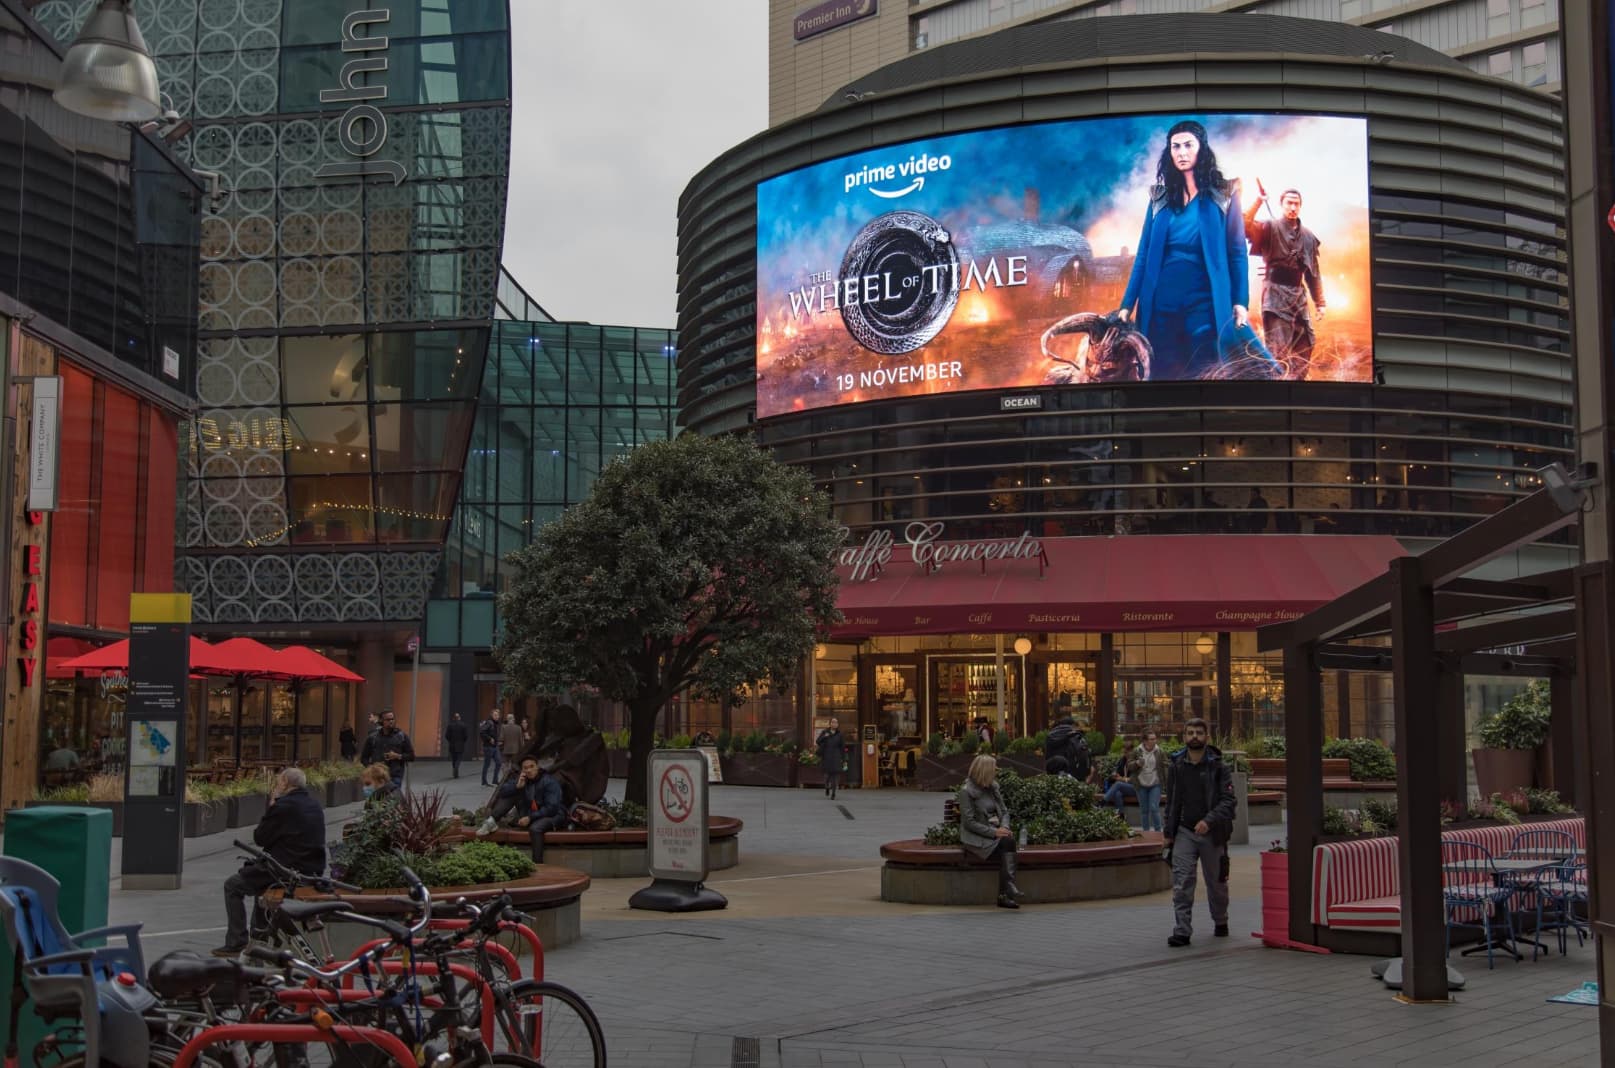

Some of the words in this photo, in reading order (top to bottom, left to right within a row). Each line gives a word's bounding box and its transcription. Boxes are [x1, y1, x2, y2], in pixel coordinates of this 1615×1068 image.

[797, 11, 834, 32] Premier
[836, 6, 851, 18] Inn
[844, 165, 895, 192] prime
[898, 153, 951, 176] video
[789, 271, 902, 320] WHEEL
[902, 275, 920, 289] OF
[922, 256, 1028, 294] TIME
[811, 270, 831, 284] THE
[837, 374, 854, 390] 19
[860, 361, 962, 388] NOVEMBER
[1004, 398, 1038, 407] OCEAN
[905, 521, 1042, 566] Concerto
[20, 545, 41, 688] EASY
[1122, 611, 1174, 621] Ristorante
[1215, 609, 1272, 622] Champagne
